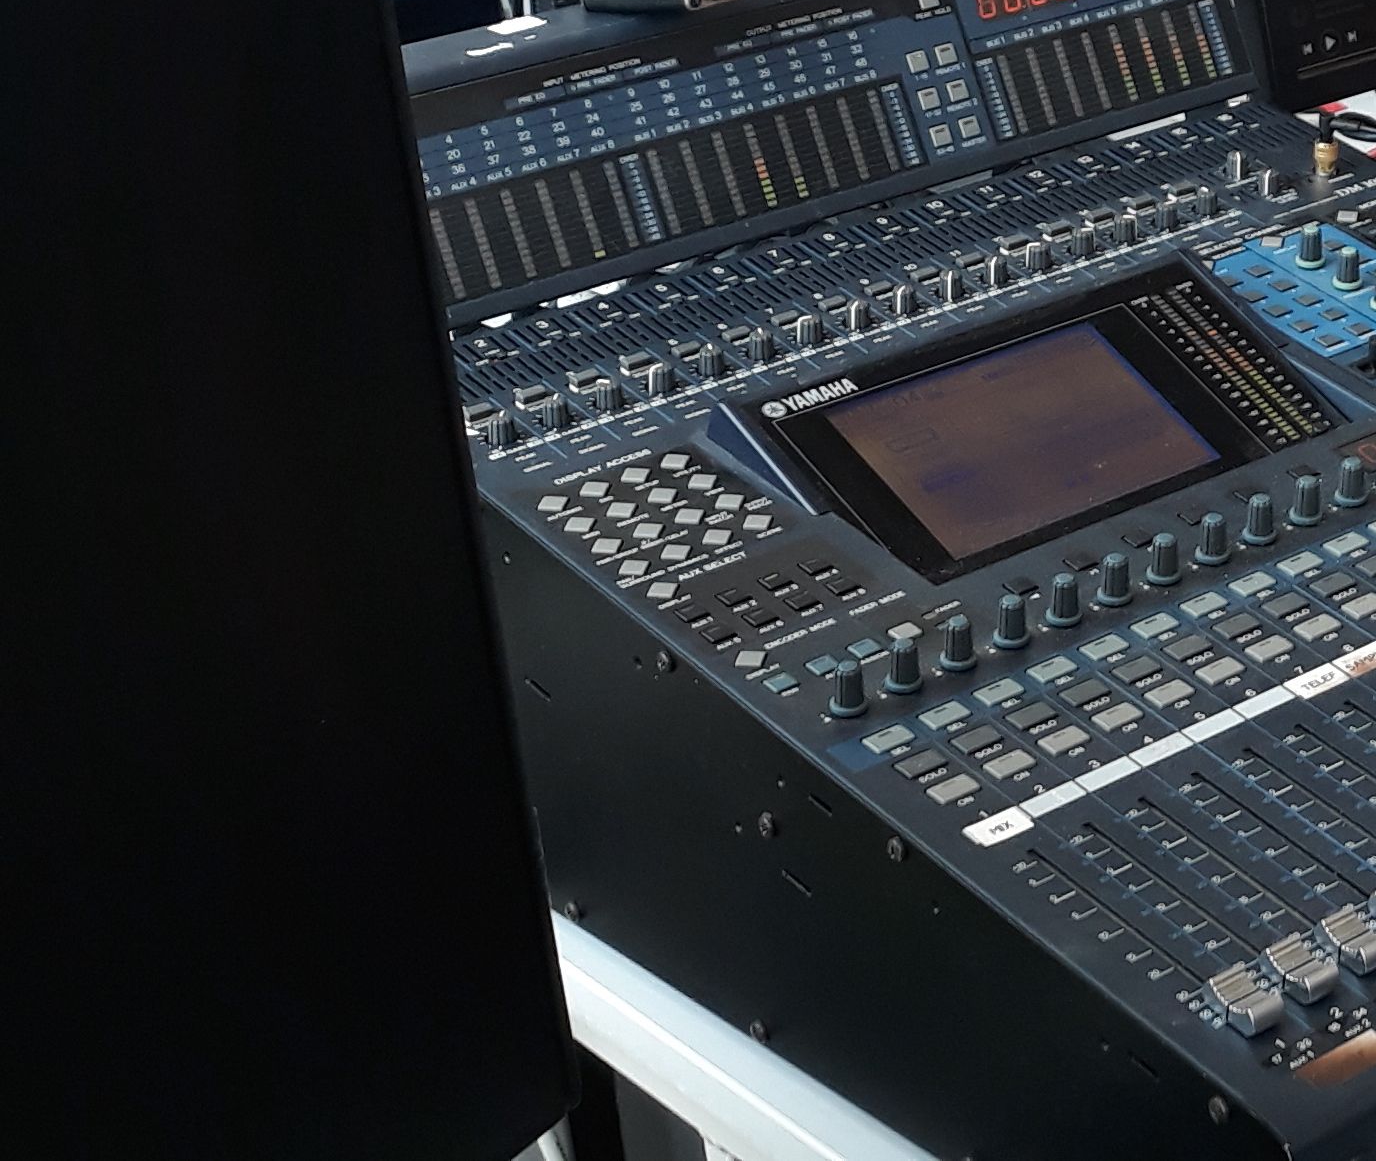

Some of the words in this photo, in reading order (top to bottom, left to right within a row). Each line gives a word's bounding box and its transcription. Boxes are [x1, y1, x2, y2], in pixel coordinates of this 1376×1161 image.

[839, 76, 847, 87] 7
[715, 109, 723, 121] 3
[746, 102, 754, 113] 4
[515, 116, 525, 127] 6
[550, 107, 558, 118] 7
[446, 149, 461, 161] 20
[483, 140, 496, 151] 21
[517, 130, 533, 142] 22
[552, 121, 566, 133] 23
[586, 112, 600, 124] 24
[630, 100, 644, 113] 25
[487, 154, 500, 167] 37
[591, 126, 605, 138] 40
[634, 115, 648, 127] 41
[666, 106, 681, 118] 42
[731, 89, 745, 100] 44
[607, 138, 616, 150] 8
[573, 147, 582, 159] 7
[538, 156, 548, 168] 6
[503, 166, 514, 178] 5
[468, 175, 478, 187] 4
[1335, 183, 1361, 197] DM
[473, 338, 489, 349] 2
[780, 378, 860, 411] YAMAHA
[553, 465, 602, 486] DISPLAY
[605, 448, 652, 469] ACCESS
[678, 568, 704, 582] AUX
[702, 550, 748, 572] SELECT
[1301, 670, 1337, 692] TELEF
[1083, 695, 1111, 712] SOLO
[1029, 719, 1058, 735] SOLO
[974, 742, 1003, 759] SOLO
[918, 767, 948, 785] SOLO
[988, 820, 1015, 837] MIX
